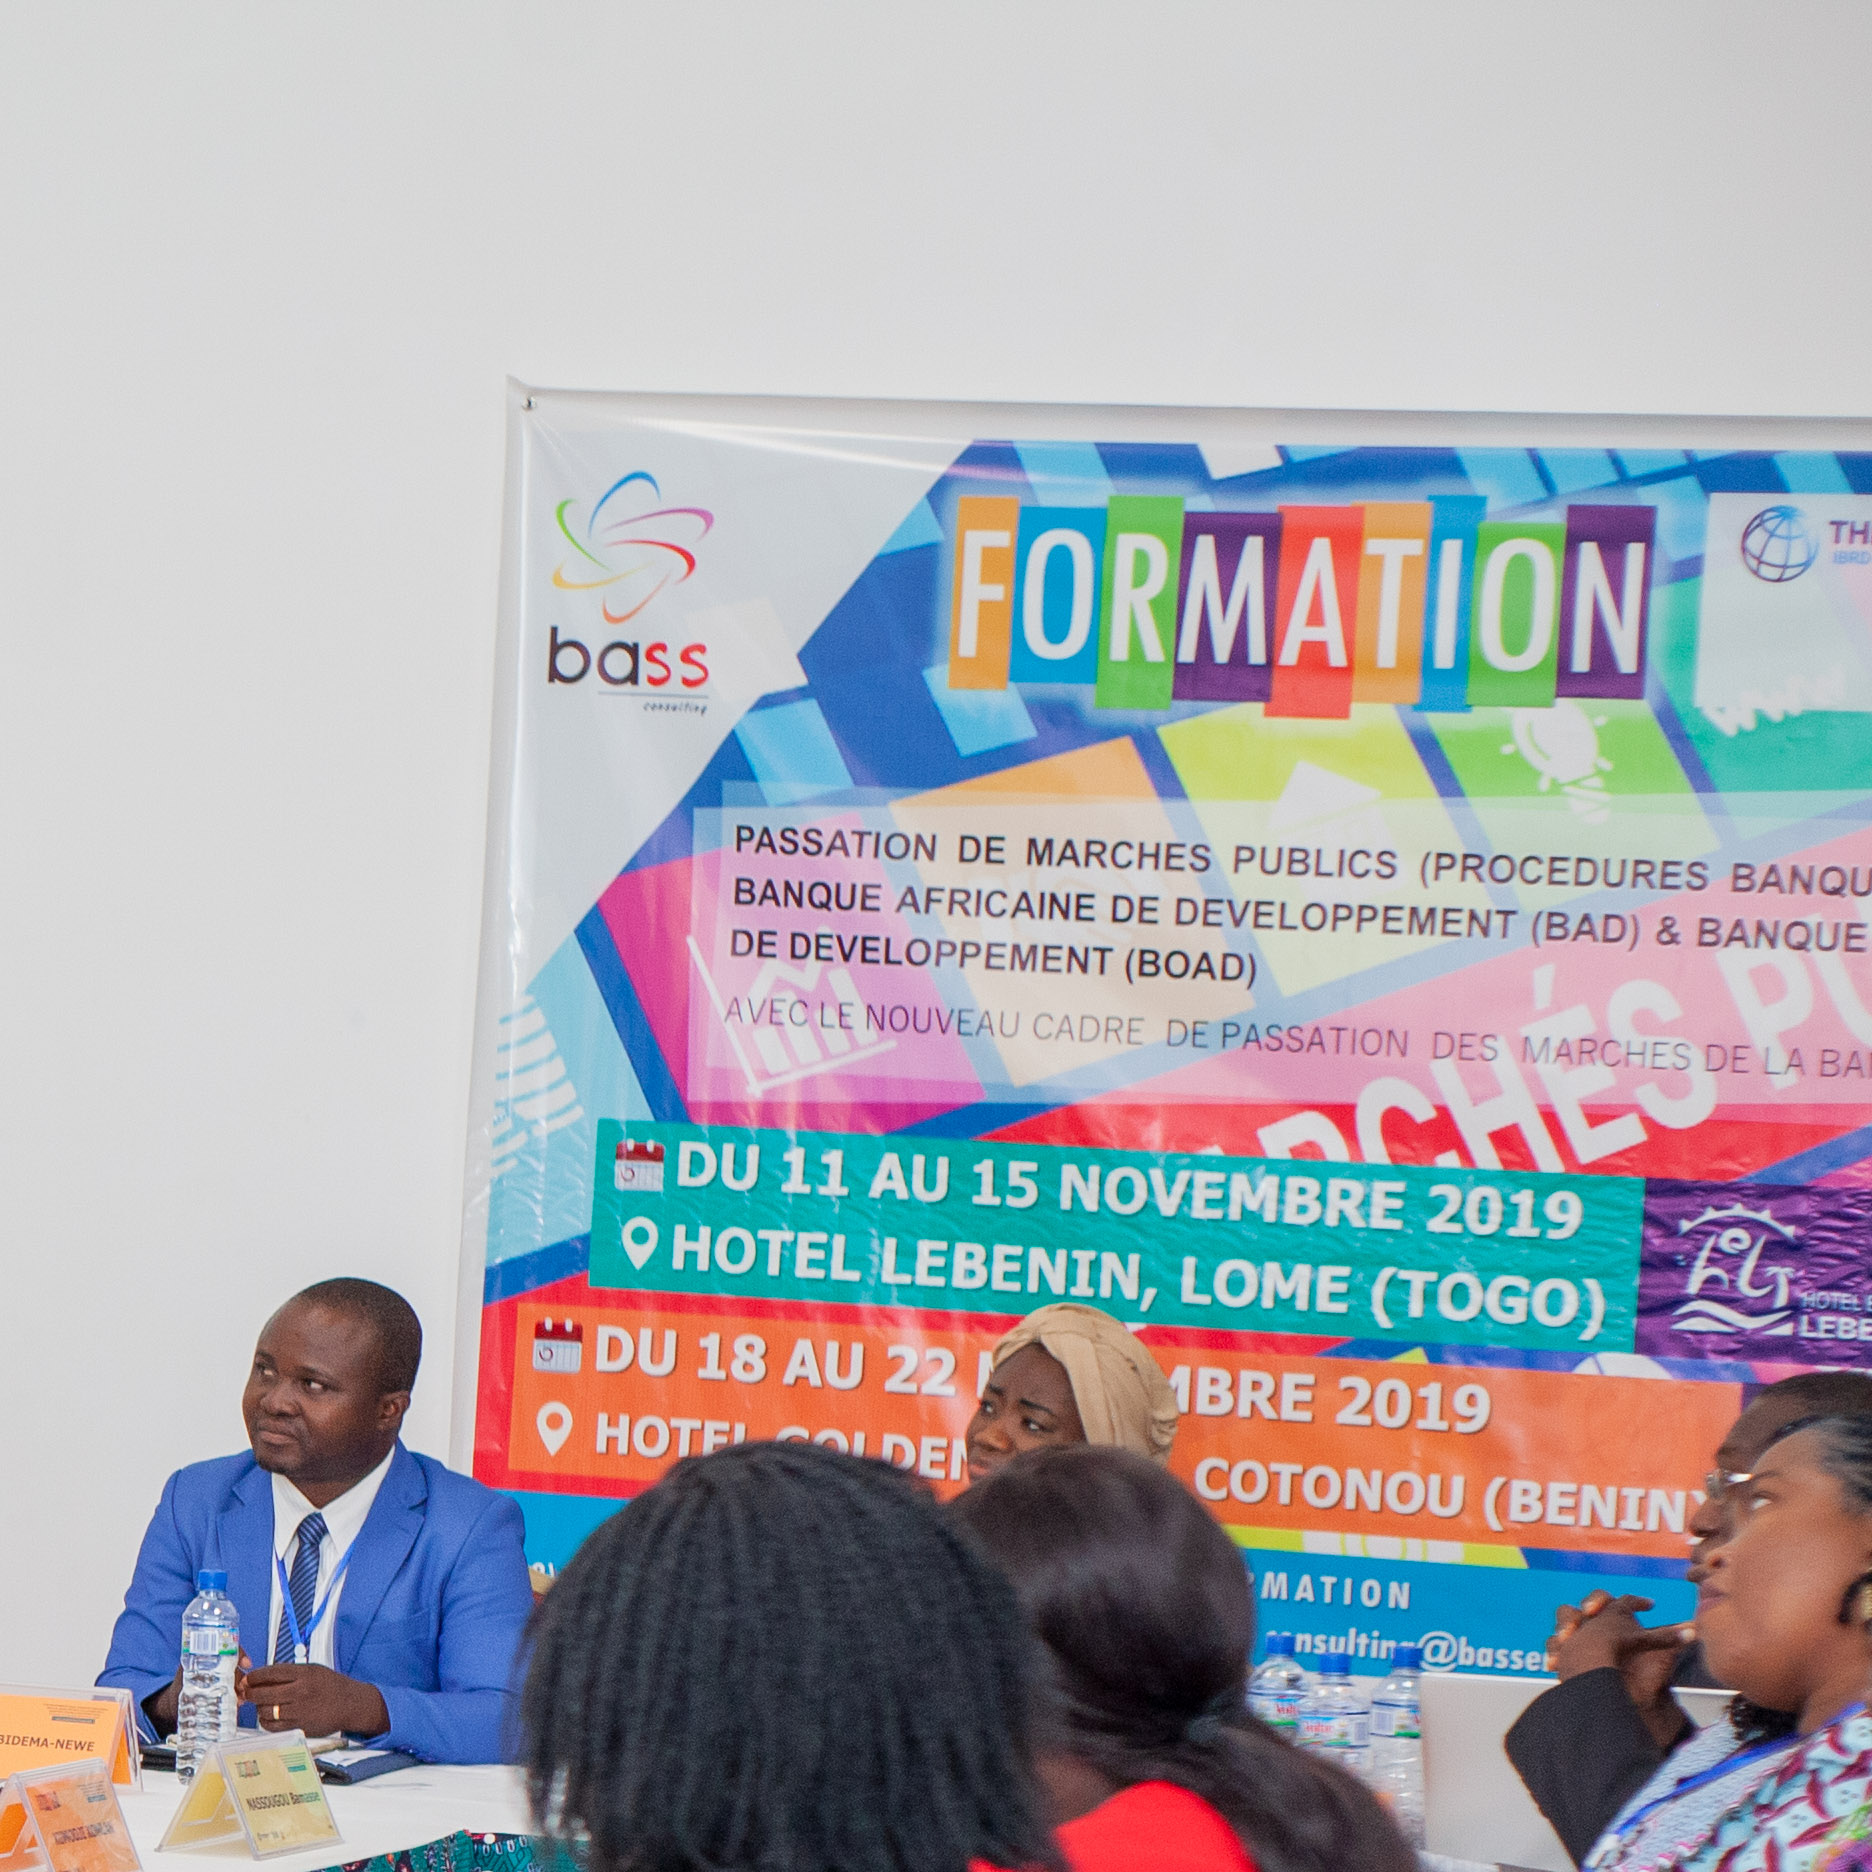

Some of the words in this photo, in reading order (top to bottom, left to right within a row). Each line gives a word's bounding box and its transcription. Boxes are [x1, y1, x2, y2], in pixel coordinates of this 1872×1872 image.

[1829, 520, 1872, 544] TH
[958, 528, 1646, 674] FORMATION
[548, 624, 709, 688] bass
[643, 701, 708, 716] consulting
[735, 824, 937, 862] PASSATION
[957, 834, 1006, 865] DE
[1025, 837, 1212, 874] MARCHES
[1233, 845, 1398, 880] PUBLICS
[1420, 851, 1710, 892] (PROCEDURES
[733, 877, 882, 913] BANQUE
[896, 886, 1096, 921] AFRICAINE
[1111, 894, 1160, 925] DE
[1175, 897, 1517, 940] DEVELOPPEMENT
[1531, 909, 1641, 950] (BAD)
[1656, 915, 1681, 946] &
[1697, 917, 1868, 953] BANQUE
[730, 930, 778, 959] DE
[790, 932, 1114, 977] DEVELOPPEMENT
[1125, 947, 1257, 990] (BOAD)
[723, 998, 809, 1029] AVEC
[818, 1001, 854, 1031] LE
[865, 1004, 1021, 1038] NOUVEAU
[1033, 1012, 1145, 1046] CADRE
[1166, 1019, 1208, 1050] DE
[1221, 1022, 1409, 1058] PASSATION
[1432, 1031, 1499, 1062] DES
[1521, 1036, 1692, 1072] MARCHES
[1704, 1043, 1752, 1074] DE
[1764, 1046, 1806, 1076] LA
[1819, 1049, 1872, 1079] BA
[678, 1142, 761, 1192] DU
[782, 1149, 849, 1198] 11
[868, 1153, 949, 1203] AU
[971, 1159, 1039, 1210] 15
[1059, 1163, 1406, 1230] NOVEMBRE
[1425, 1183, 1584, 1240] 2019
[671, 1224, 861, 1281] HOTEL
[881, 1237, 1158, 1312] LEBENIN,
[1180, 1256, 1351, 1314] LOME
[1370, 1265, 1607, 1342] (TOGO)
[1801, 1291, 1862, 1312] HOTEL
[594, 1326, 677, 1377] DU
[696, 1334, 766, 1383] 18
[783, 1338, 864, 1391] AU
[884, 1346, 957, 1397] 22
[1335, 1376, 1492, 1434] 2019
[1194, 1457, 1465, 1518] COTONOU
